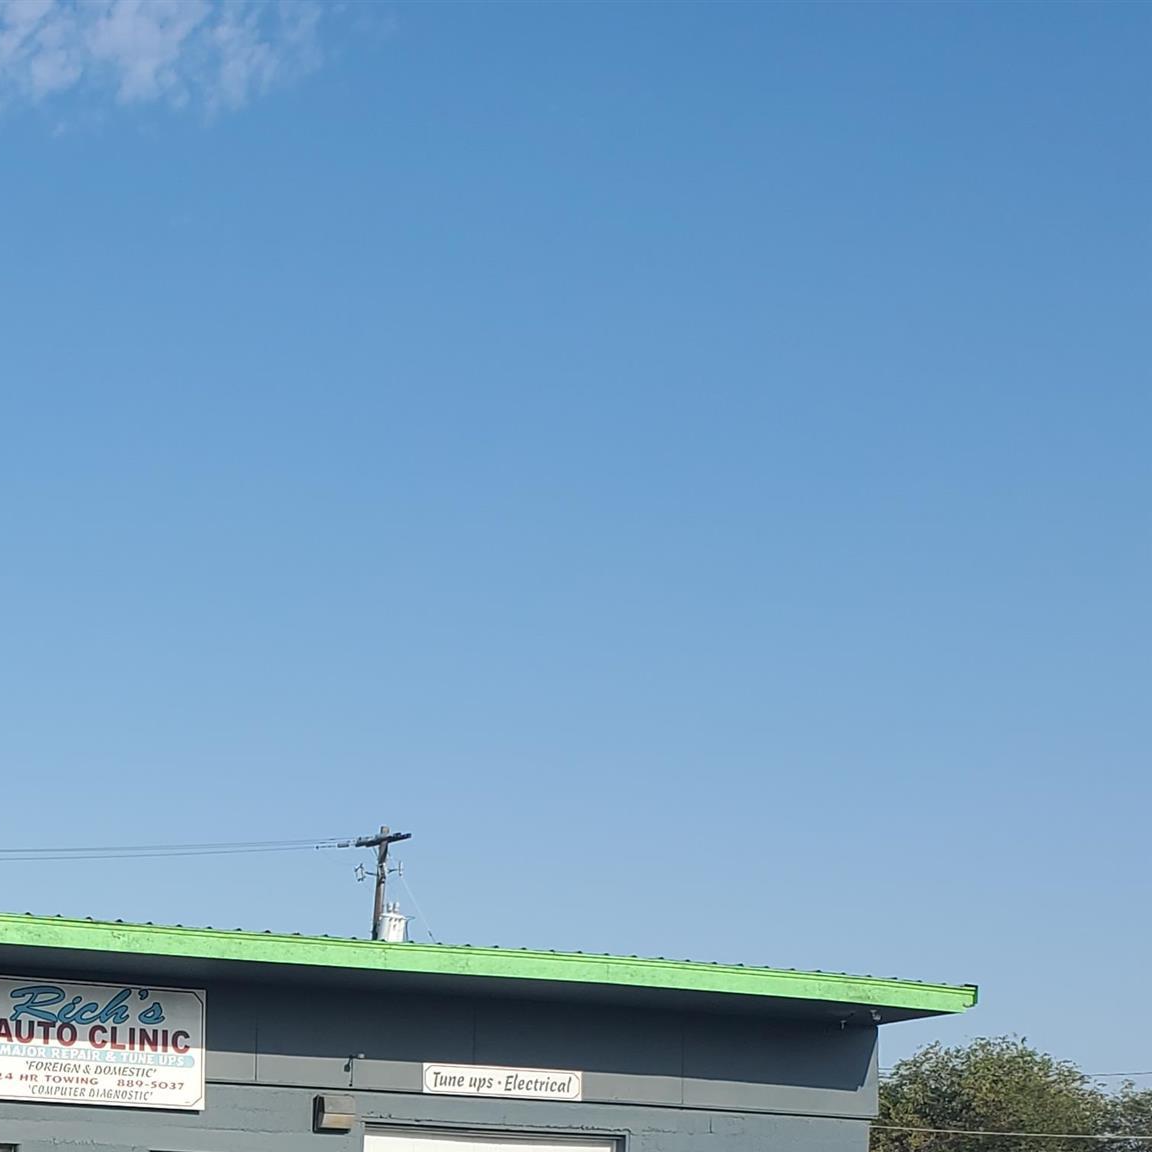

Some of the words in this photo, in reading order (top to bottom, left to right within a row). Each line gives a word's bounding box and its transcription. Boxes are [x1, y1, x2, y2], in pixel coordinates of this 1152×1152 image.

[9, 985, 165, 1025] Rich's
[88, 1024, 191, 1054] CLINIC
[0, 1044, 46, 1058] MAJOR
[52, 1047, 101, 1061] REPAIR
[105, 1051, 117, 1062] &
[120, 1053, 153, 1065] TUNE
[159, 1056, 185, 1067] UPS
[82, 1064, 92, 1075] &
[19, 1073, 39, 1083] HR
[44, 1074, 99, 1086] TOWING
[116, 1079, 185, 1091] 889-5037
[433, 1072, 464, 1088] Tune
[468, 1076, 493, 1092] ups
[504, 1073, 572, 1093] Electrical
